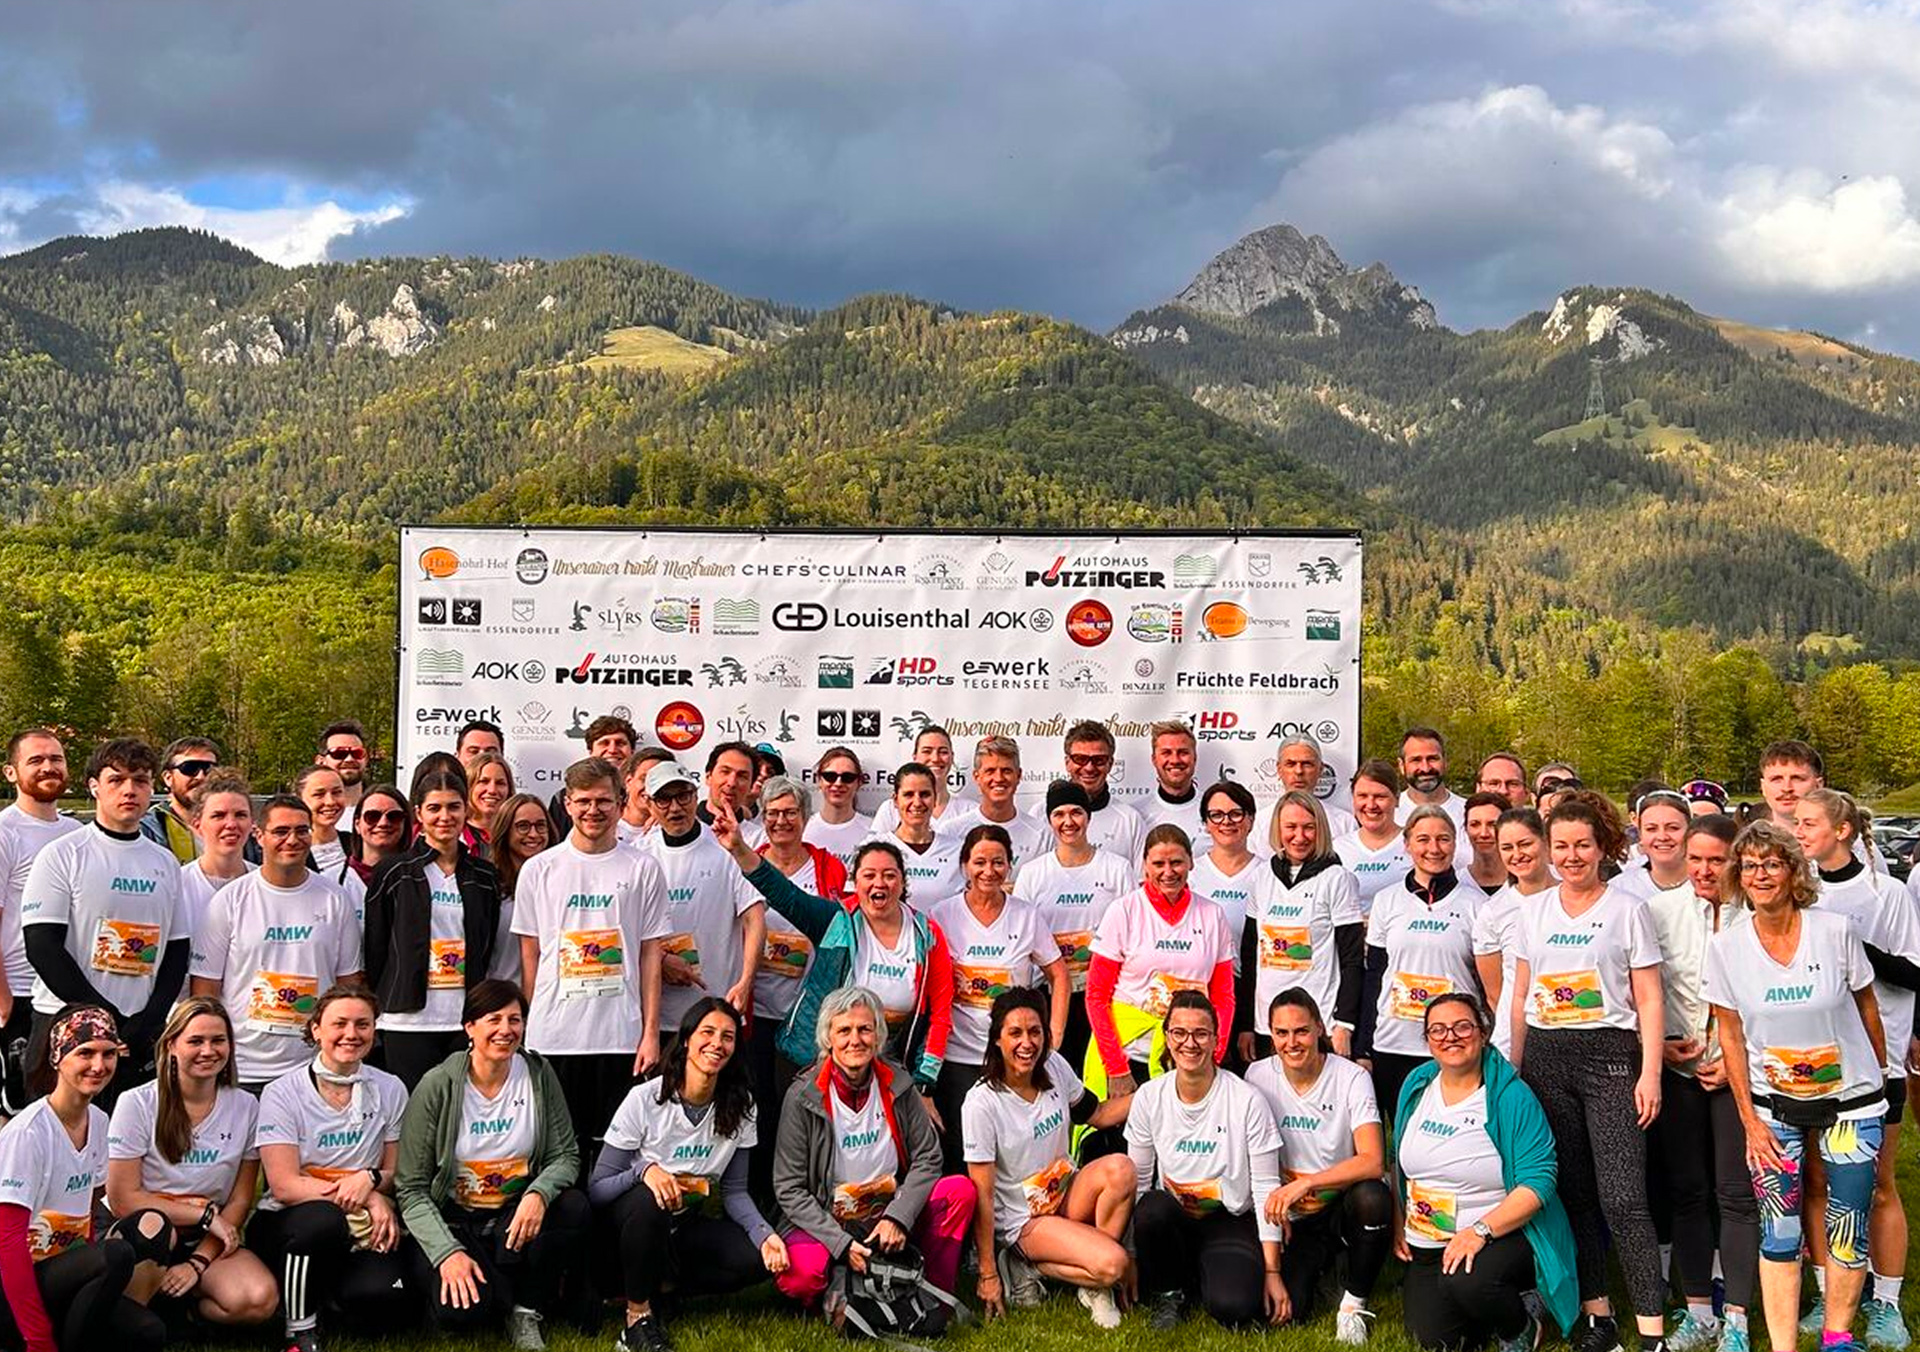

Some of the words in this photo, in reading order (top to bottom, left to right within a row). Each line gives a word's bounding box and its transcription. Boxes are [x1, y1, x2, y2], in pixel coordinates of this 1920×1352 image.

[1073, 556, 1149, 567] AUTOHAUS
[818, 565, 907, 578] CULINAR
[1222, 581, 1298, 589] ESSENDORFER
[598, 606, 643, 631] SLYRS
[834, 608, 970, 628] Louisenthal
[978, 611, 1027, 629] AOK
[486, 626, 560, 634] ESSENDORFER
[602, 653, 677, 665] AUTOHAUS
[899, 657, 937, 674] HD
[471, 661, 519, 680] AOK
[896, 675, 955, 688] sports
[963, 679, 1050, 690] TEGERNSEE
[1122, 683, 1166, 691] DINZLER
[1176, 671, 1244, 688] Früchte
[1249, 673, 1339, 690] Feldbrach
[1200, 711, 1239, 729] HD
[716, 715, 767, 741] SLYRS
[1266, 722, 1314, 740] AOK
[1197, 730, 1257, 742] sports
[1354, 862, 1391, 873] AMW
[111, 876, 156, 894] AMW
[567, 894, 613, 908] AMW
[668, 888, 696, 901] MW
[1056, 893, 1095, 905] AMW
[1211, 889, 1248, 900] AMW
[1268, 905, 1303, 918] AMW
[1408, 920, 1451, 932] AMW
[264, 926, 313, 941] AMW
[1547, 933, 1595, 946] AMW
[967, 946, 1006, 957] AMW
[1155, 939, 1193, 951] AMW
[441, 953, 459, 967] 37
[868, 963, 907, 978] AMW
[972, 978, 989, 990] 68
[278, 987, 299, 1003] 98
[1410, 987, 1428, 1001] 89
[1554, 987, 1575, 1002] 83
[1764, 984, 1815, 1003] AMW
[470, 1118, 514, 1136] AMW
[1033, 1109, 1064, 1140] AMW
[1280, 1115, 1322, 1131] AMW
[1419, 1119, 1460, 1137] AMW
[317, 1129, 364, 1149] AMW
[841, 1129, 880, 1150] AMW
[1175, 1140, 1218, 1154] AMW
[181, 1149, 220, 1164] MW
[1416, 1200, 1432, 1217] 52
